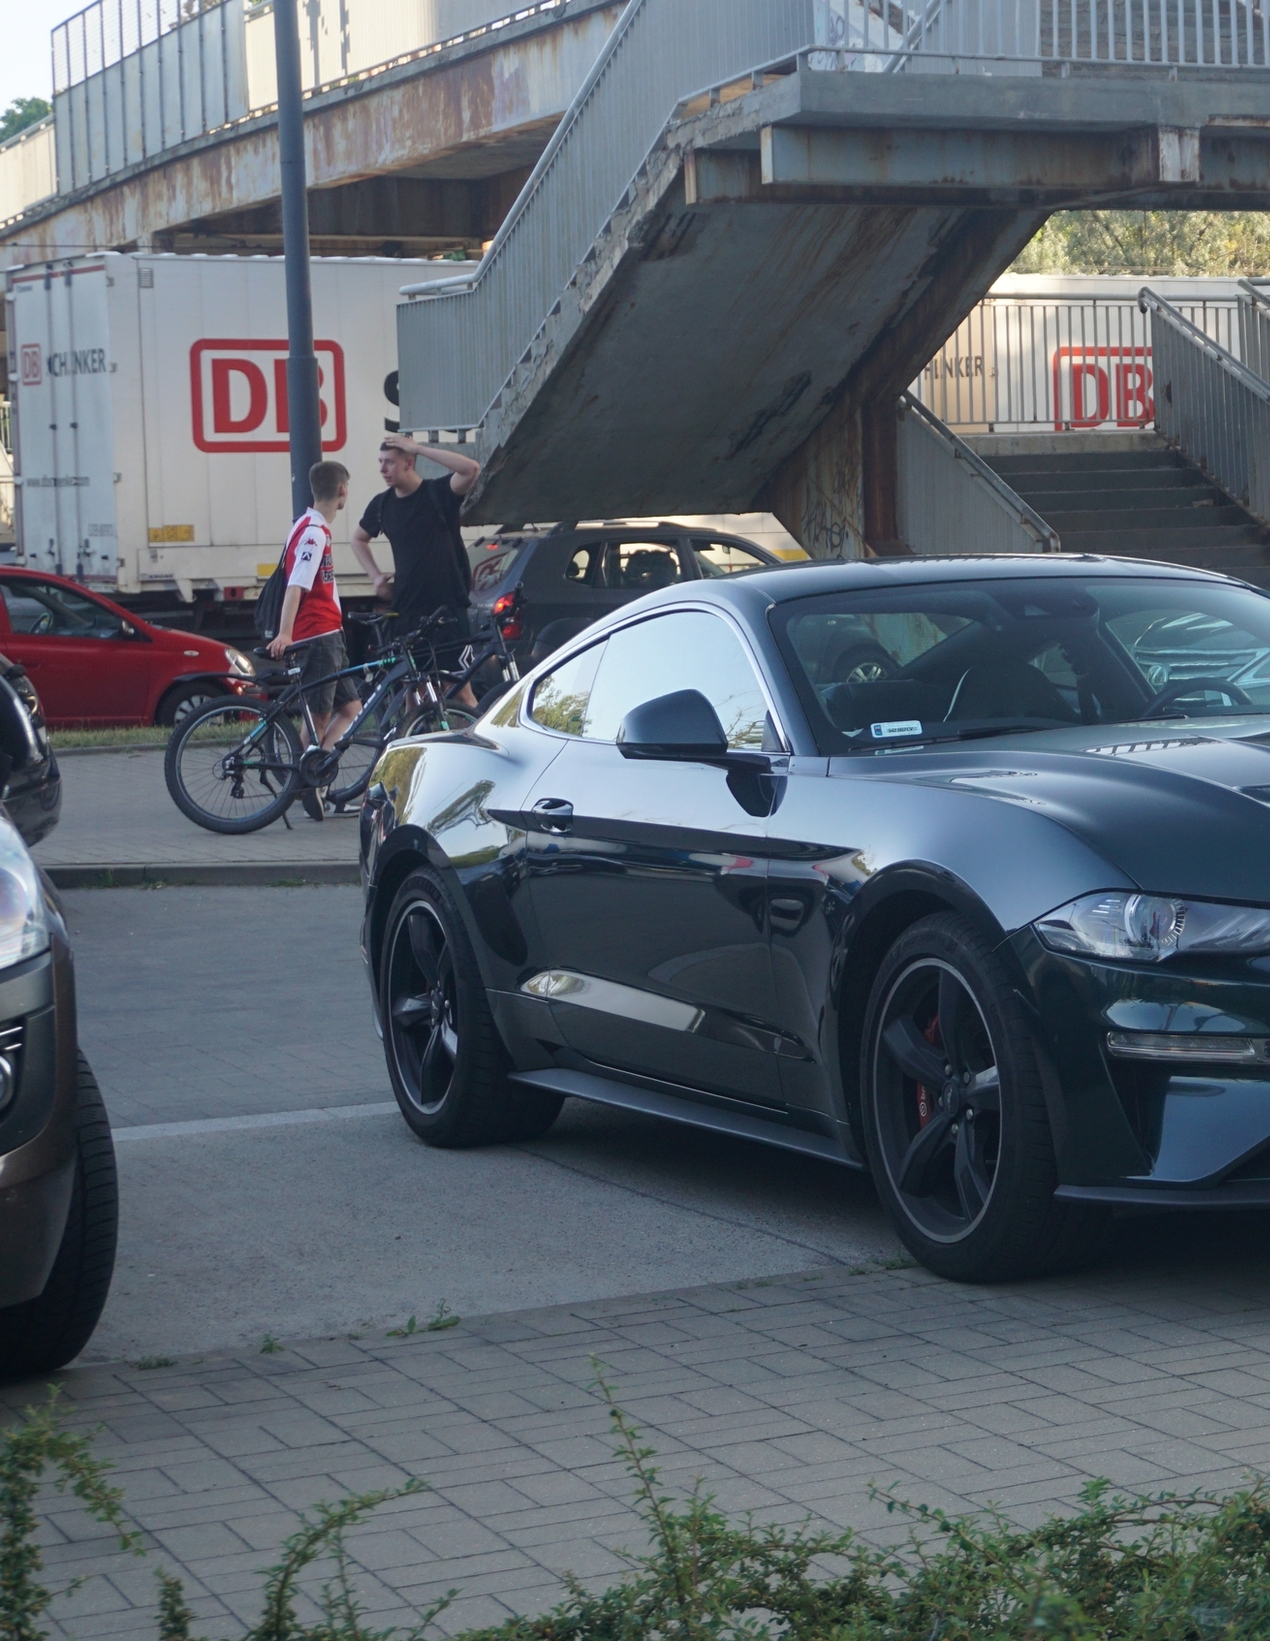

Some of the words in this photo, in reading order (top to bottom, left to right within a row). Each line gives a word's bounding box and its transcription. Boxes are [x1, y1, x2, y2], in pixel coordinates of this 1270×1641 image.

[23, 350, 40, 379] DB
[47, 348, 107, 377] CHNKER
[1071, 364, 1155, 428] DB
